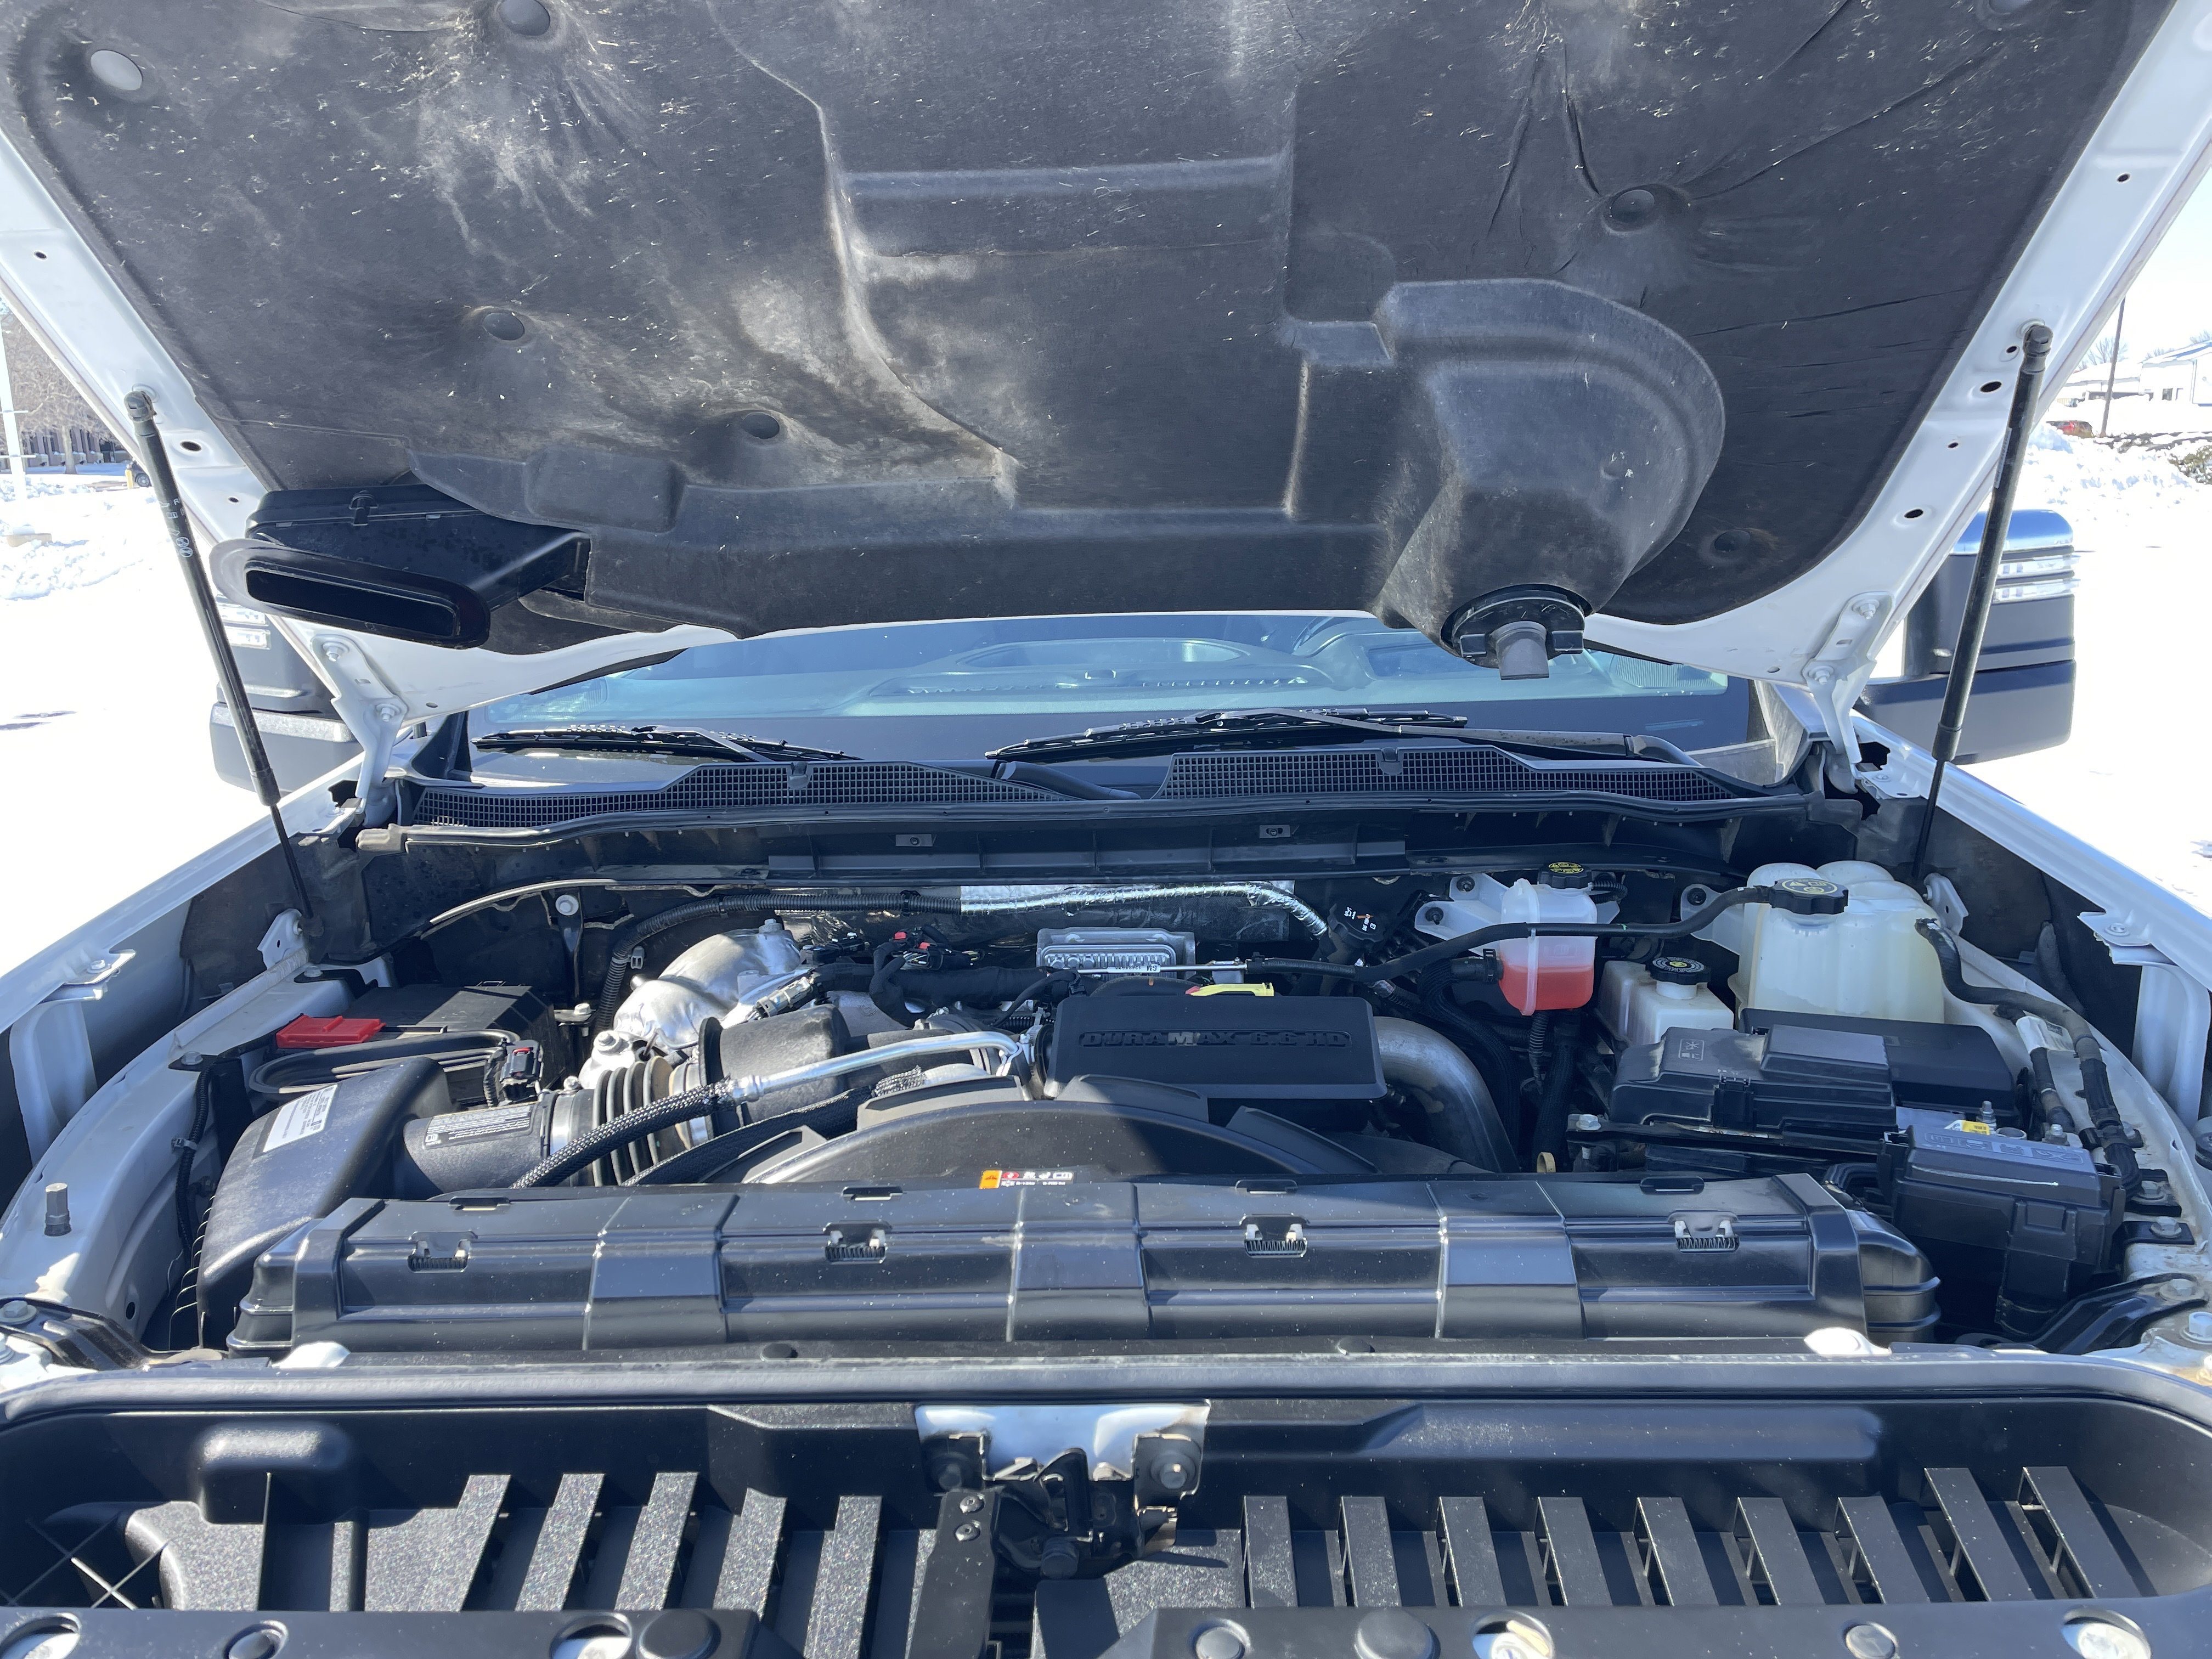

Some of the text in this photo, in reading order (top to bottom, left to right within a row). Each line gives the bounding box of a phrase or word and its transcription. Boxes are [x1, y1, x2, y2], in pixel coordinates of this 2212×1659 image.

[1082, 1031, 1347, 1048] DURAMAX 6.6 HD
